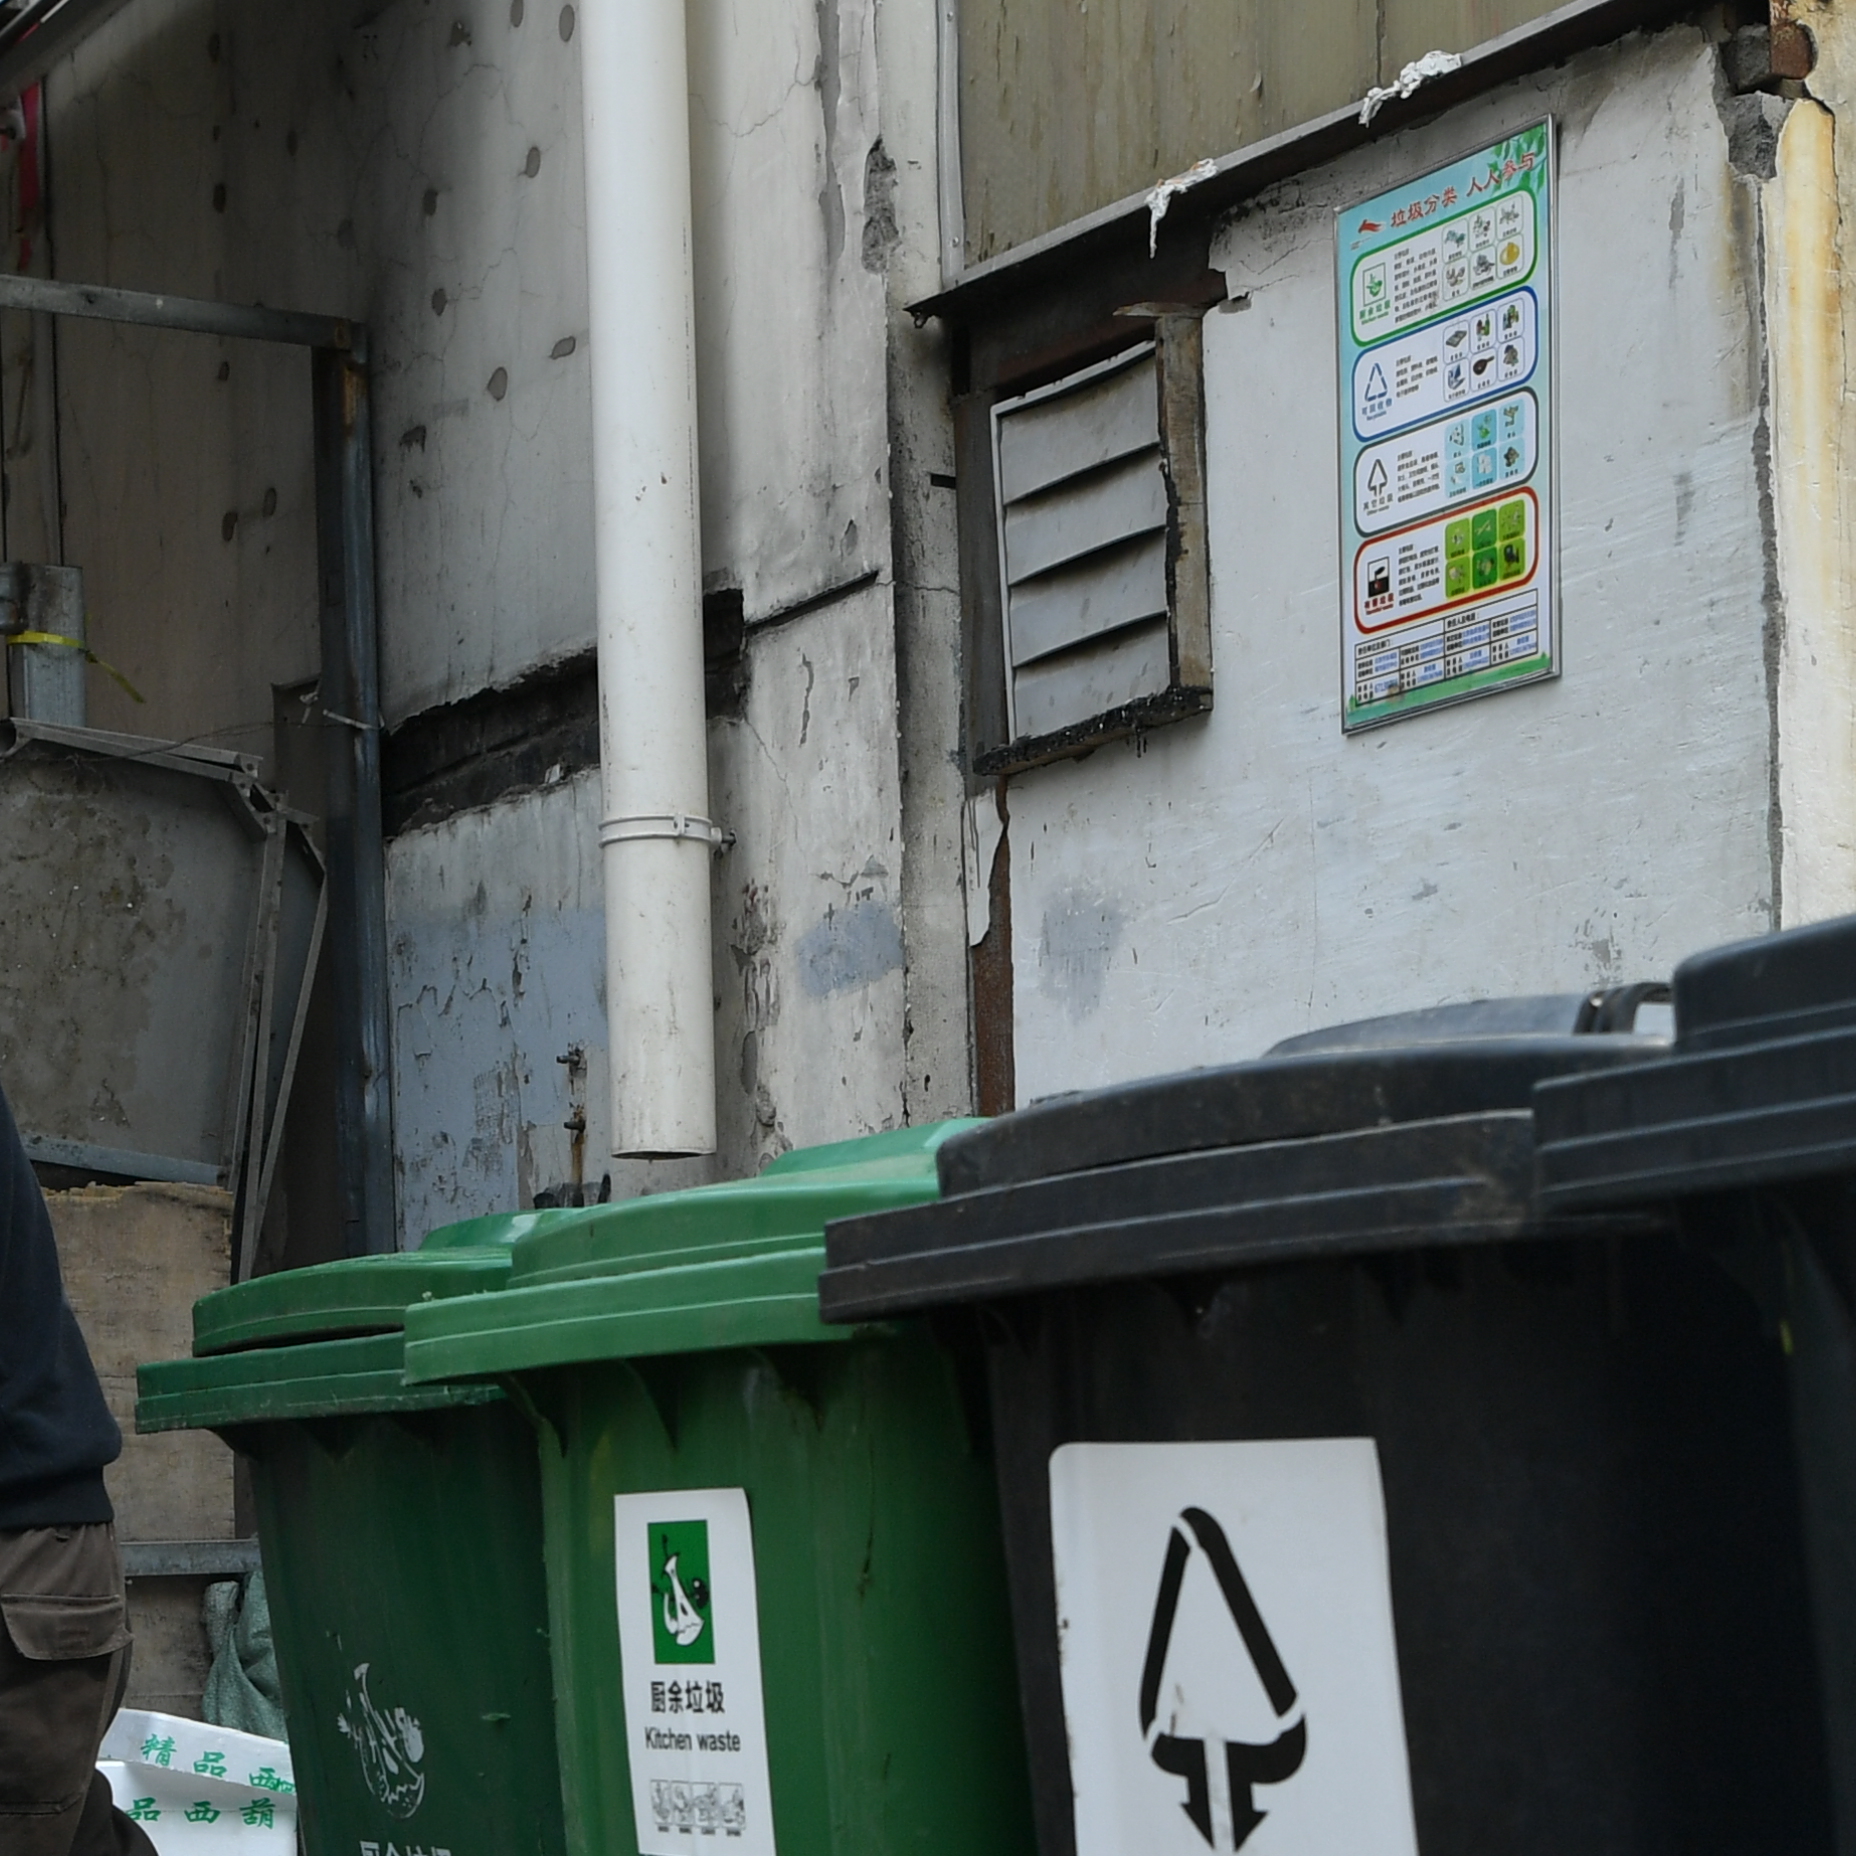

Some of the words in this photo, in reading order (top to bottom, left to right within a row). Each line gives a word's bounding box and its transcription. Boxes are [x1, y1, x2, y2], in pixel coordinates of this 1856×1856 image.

[1390, 186, 1458, 228] 垃圾分类
[1466, 151, 1536, 198] 人人参与
[650, 1679, 726, 1714] 厨余垃圾
[644, 1726, 693, 1751] Kitchen
[697, 1730, 742, 1752] waste
